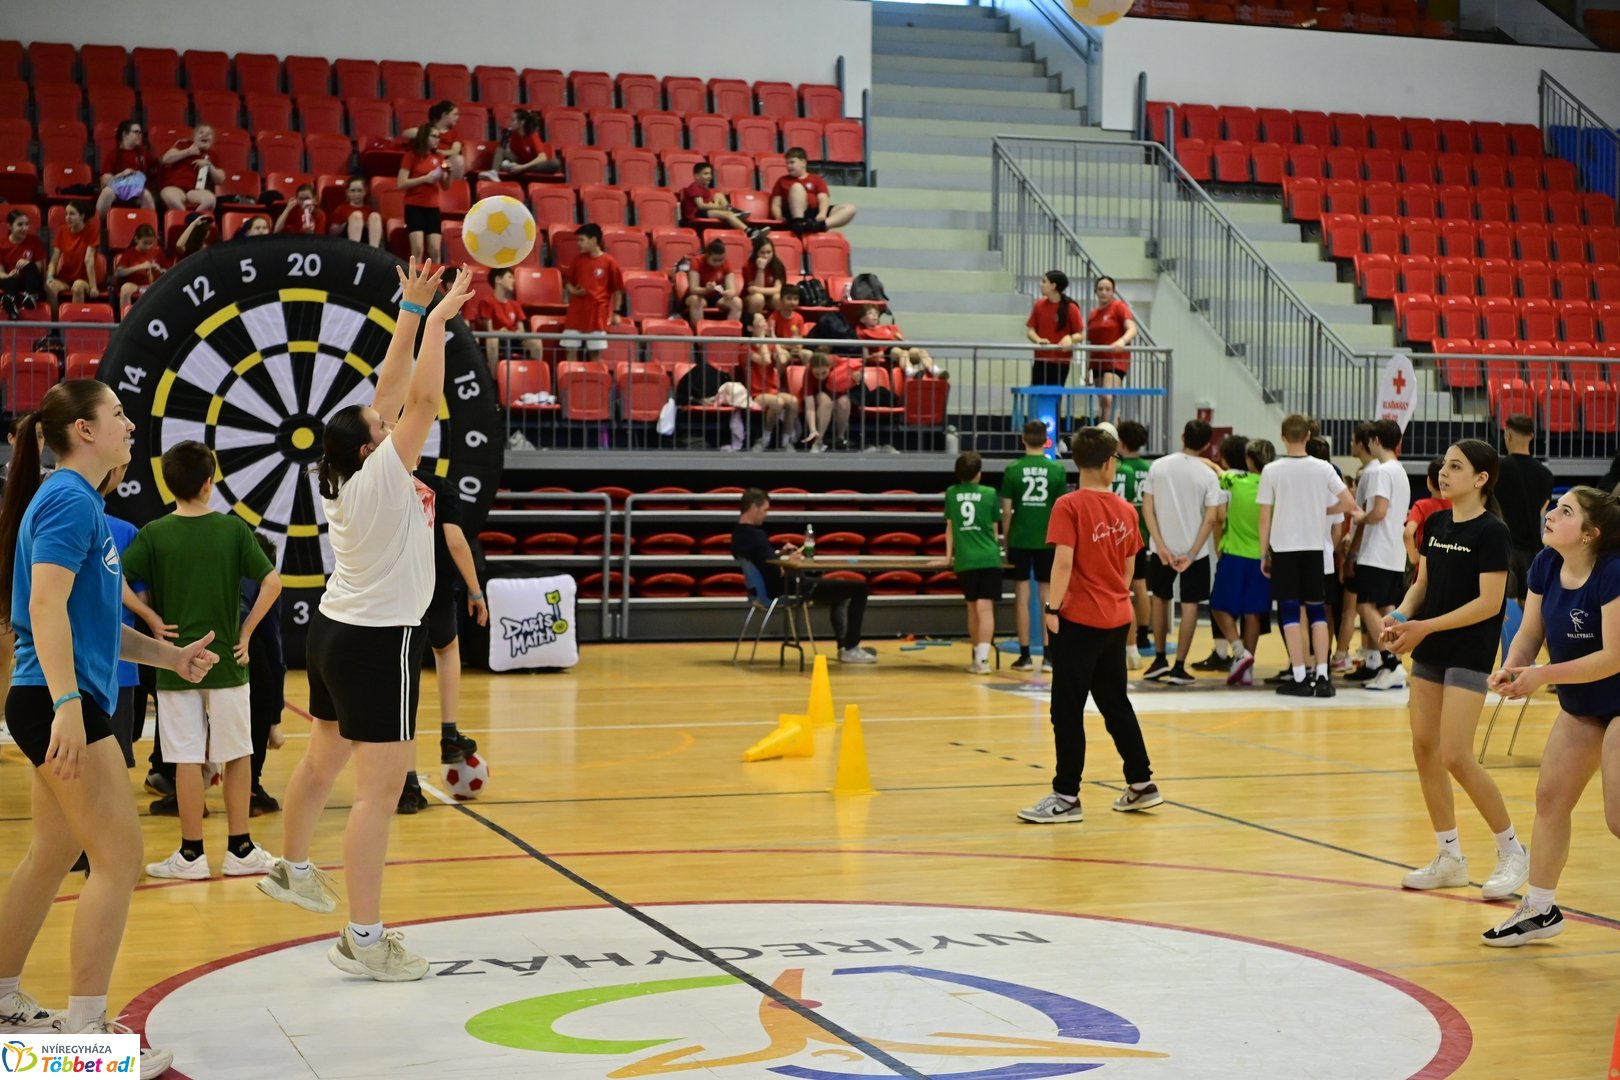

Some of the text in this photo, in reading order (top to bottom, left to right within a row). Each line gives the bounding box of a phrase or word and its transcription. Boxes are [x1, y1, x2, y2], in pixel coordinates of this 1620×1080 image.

[240, 258, 257, 283] 5
[288, 252, 322, 277] 20
[353, 262, 366, 286] 1
[183, 275, 215, 306] 12
[147, 319, 169, 341] 9
[118, 364, 147, 394] 14
[454, 371, 480, 400] 13
[465, 430, 488, 448] 6
[1023, 466, 1048, 476] BEM
[117, 480, 141, 498] 8
[459, 476, 481, 502] 10
[957, 492, 982, 502] BEM
[1022, 476, 1048, 502] 23
[961, 501, 975, 526] 9
[1429, 536, 1471, 553] Champion
[294, 601, 309, 624] 3
[428, 930, 1052, 976] NYÍREGYHÁZ
